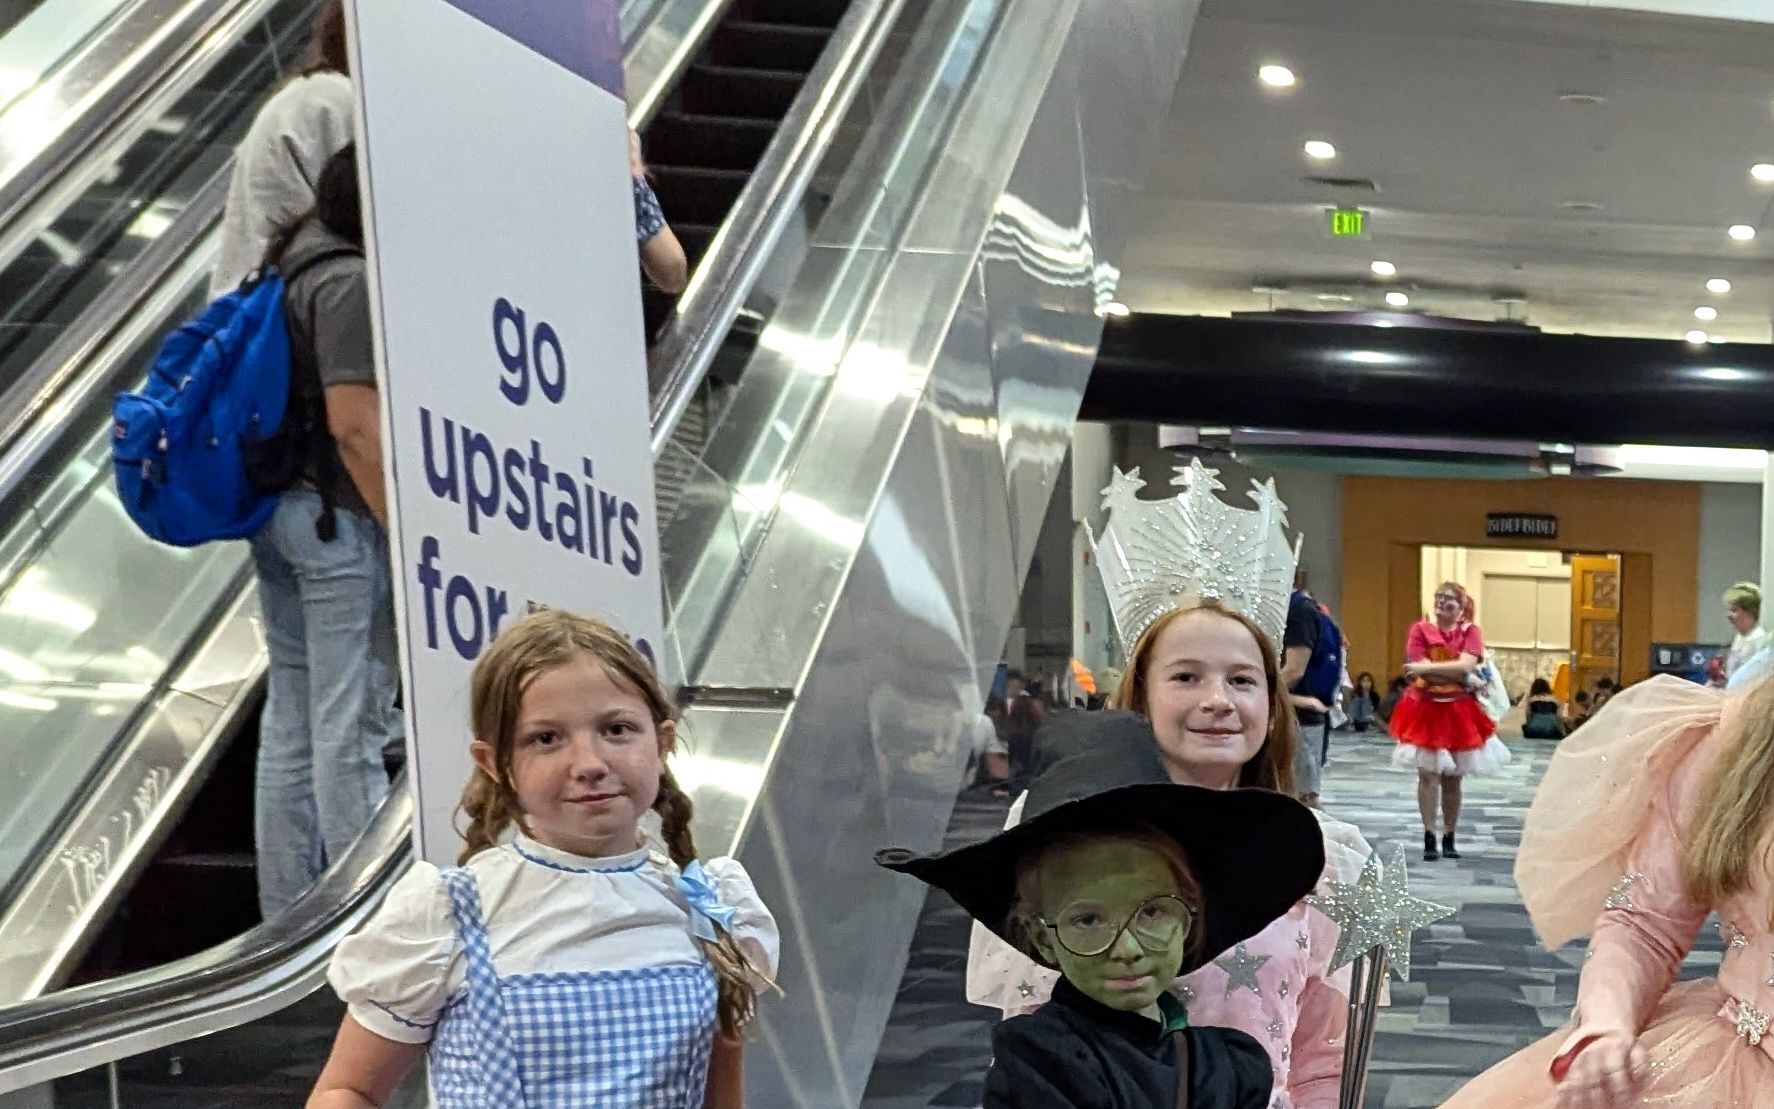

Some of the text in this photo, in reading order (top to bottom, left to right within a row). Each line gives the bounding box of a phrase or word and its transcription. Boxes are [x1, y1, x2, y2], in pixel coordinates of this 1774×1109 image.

[1333, 212, 1362, 235] EXIT
[493, 297, 566, 406] go
[419, 407, 643, 576] upstairs
[417, 536, 508, 660] for
